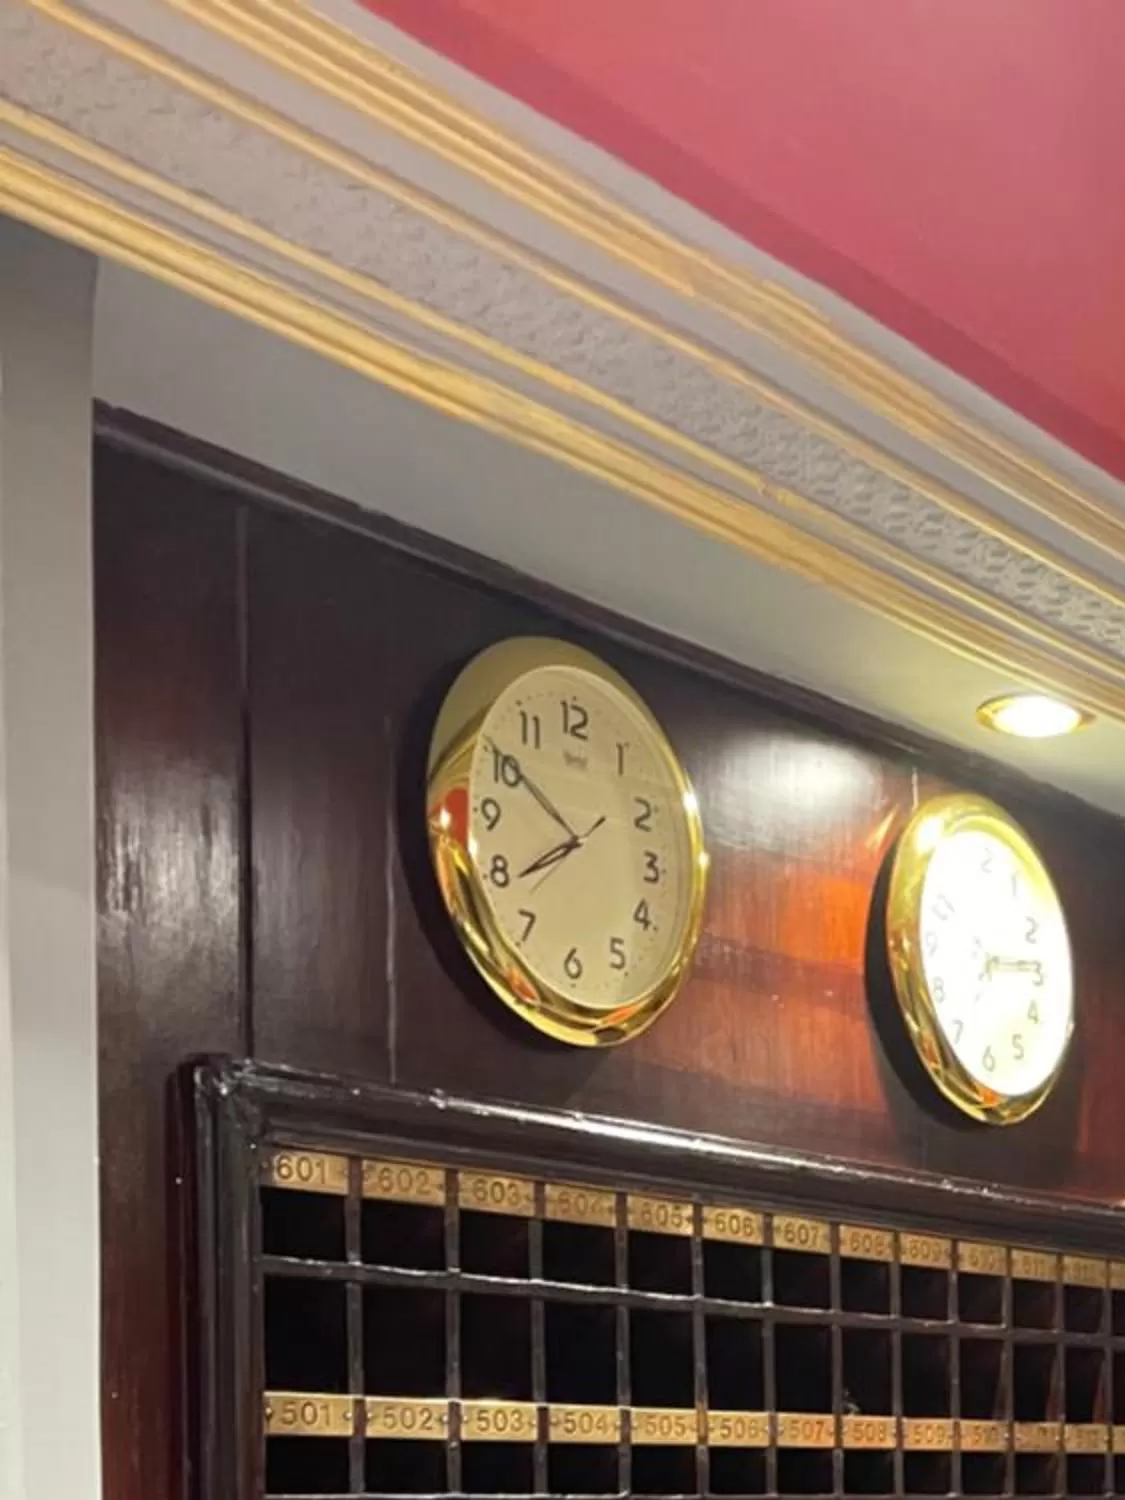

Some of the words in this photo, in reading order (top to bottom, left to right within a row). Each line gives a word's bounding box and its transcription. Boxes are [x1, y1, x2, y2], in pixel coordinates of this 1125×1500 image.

[520, 710, 541, 749] 11
[560, 700, 590, 741] 12
[492, 745, 520, 787] 10
[616, 743, 626, 776] 1
[480, 798, 500, 831] 9
[633, 797, 653, 832] 2
[490, 854, 510, 889] 8
[643, 852, 660, 884] 3
[518, 909, 536, 942] 7
[633, 898, 650, 932] 4
[1025, 916, 1038, 944] 2
[563, 948, 583, 979] 6
[610, 937, 626, 971] 5
[933, 976, 945, 1003] 8
[1027, 1000, 1038, 1024] 4
[952, 1019, 964, 1044] 7
[982, 1046, 996, 1072] 6
[1012, 1034, 1025, 1060] 5
[276, 1154, 327, 1185] 601
[378, 1167, 432, 1196] 602
[472, 1178, 519, 1206] 603
[640, 1202, 683, 1229] 605
[714, 1212, 757, 1238] 606
[783, 1221, 819, 1246] 607
[281, 1401, 331, 1427] 501
[382, 1406, 434, 1430] 502
[476, 1408, 524, 1433] 503
[563, 1410, 610, 1435] 504
[644, 1414, 687, 1438] 505
[719, 1417, 757, 1440] 506
[790, 1420, 825, 1442] 507
